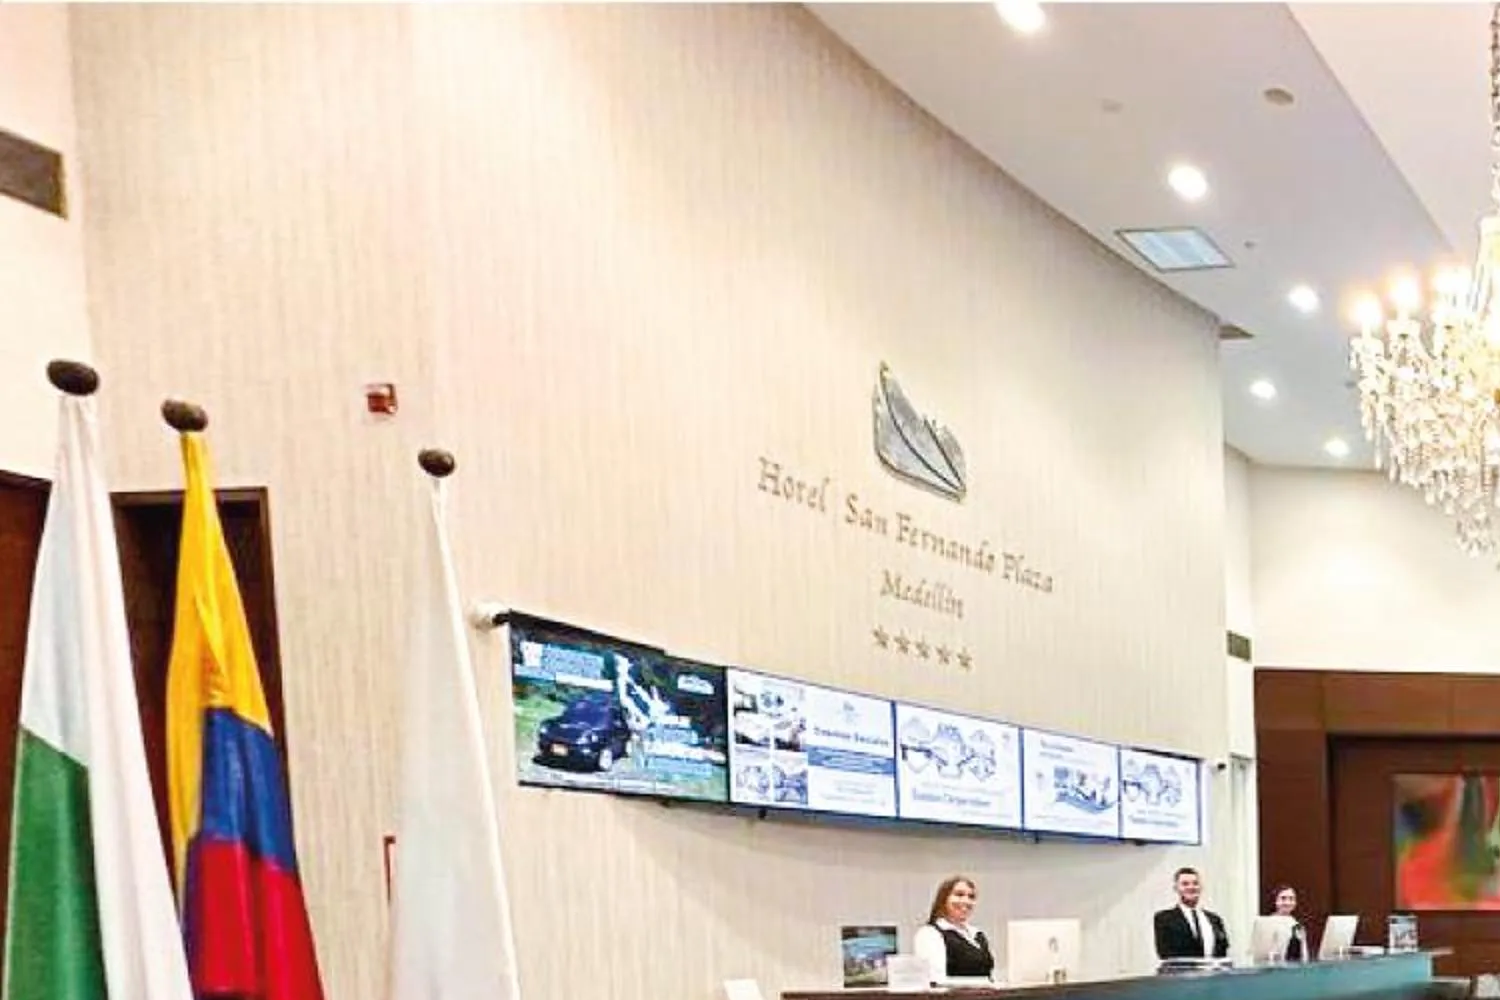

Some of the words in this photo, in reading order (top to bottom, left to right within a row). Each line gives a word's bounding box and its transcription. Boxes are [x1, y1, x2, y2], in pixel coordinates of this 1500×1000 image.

[757, 456, 831, 513] Hotel
[845, 493, 888, 535] San
[895, 511, 995, 572] Fernando
[1001, 552, 1054, 593] Plaza
